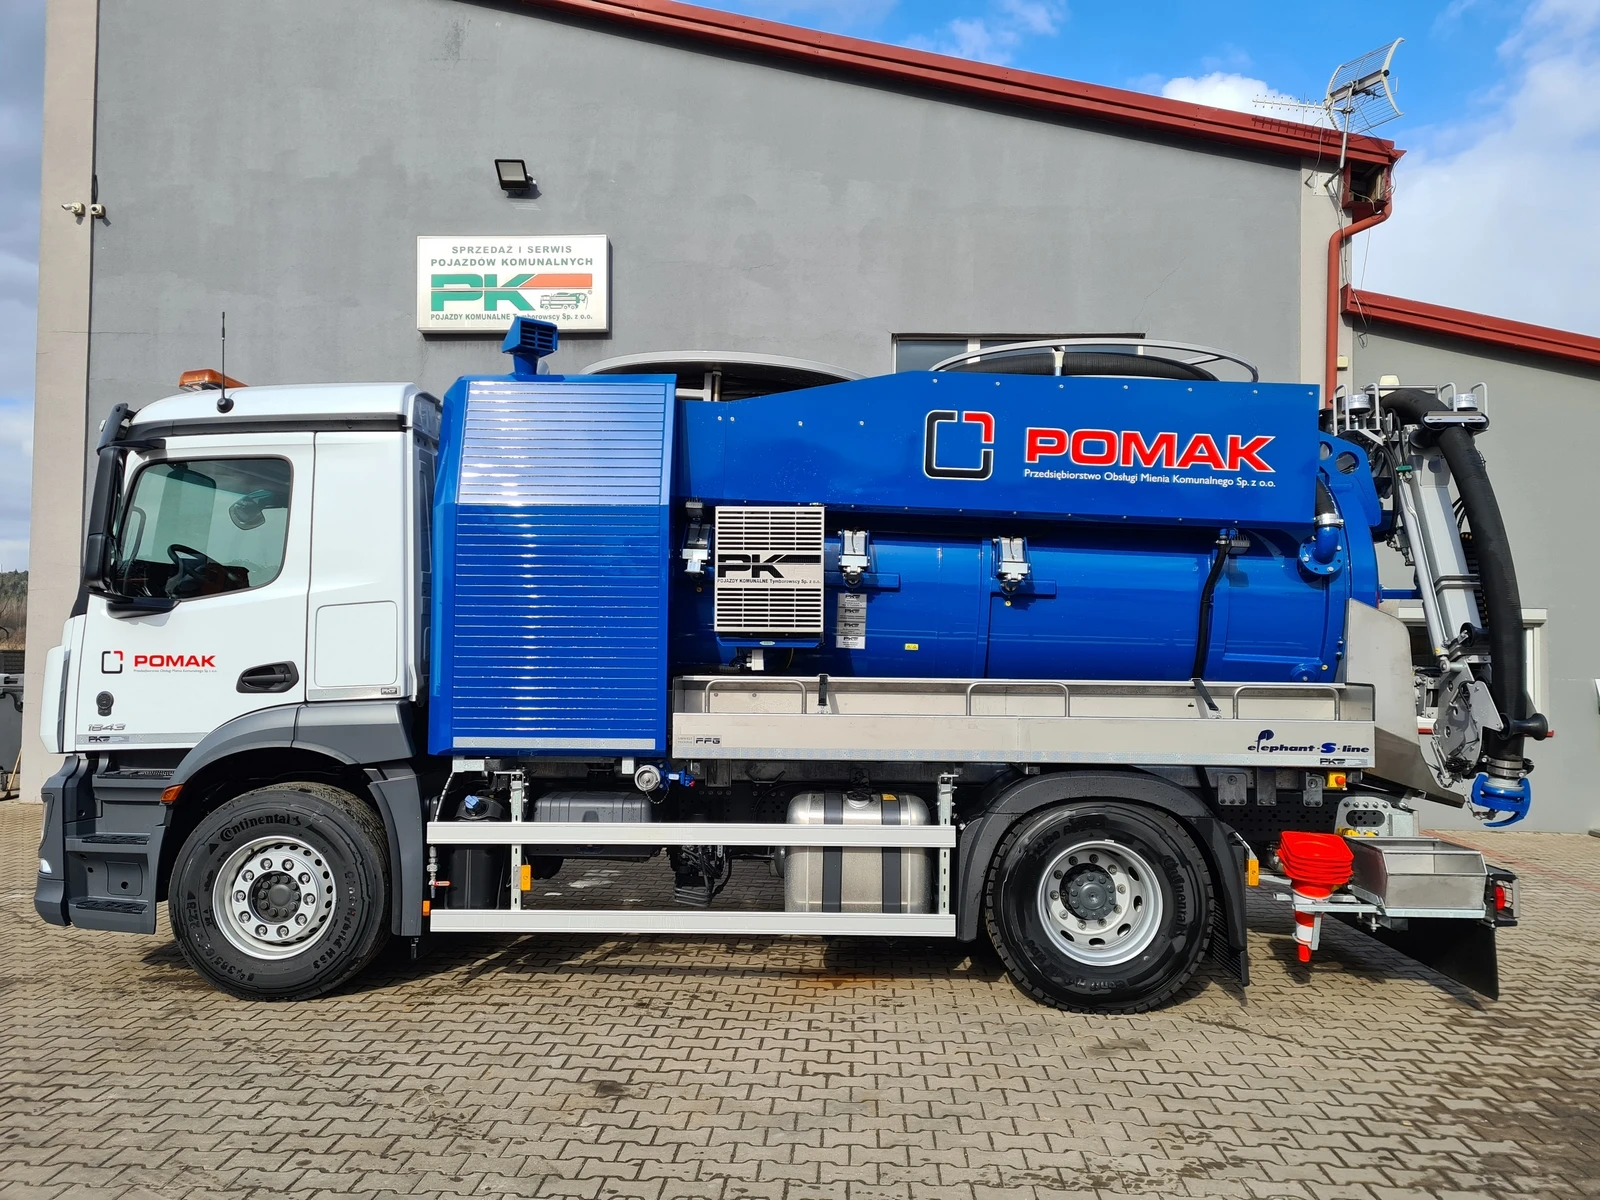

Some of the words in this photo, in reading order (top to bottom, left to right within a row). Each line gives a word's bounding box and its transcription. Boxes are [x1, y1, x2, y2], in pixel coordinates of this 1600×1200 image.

[452, 245, 513, 254] SPRZEDAŻ
[518, 246, 522, 254] I
[527, 245, 572, 254] SERWIS
[431, 256, 496, 267] POJAZDÓW
[501, 257, 593, 266] KOMUNALNYCH
[431, 273, 536, 311] PK
[430, 313, 463, 321] POJAZDY
[1025, 427, 1276, 473] POMAK
[1024, 469, 1101, 480] Przedsiębiorstwo
[1104, 472, 1138, 483] Obsługi
[1141, 473, 1170, 483] Mienia
[1173, 475, 1234, 486] Komunalnego
[1236, 477, 1250, 488] Sp.
[717, 554, 784, 578] PK
[134, 655, 216, 667] POMAK
[88, 723, 126, 731] 1843
[220, 813, 291, 842] Continental
